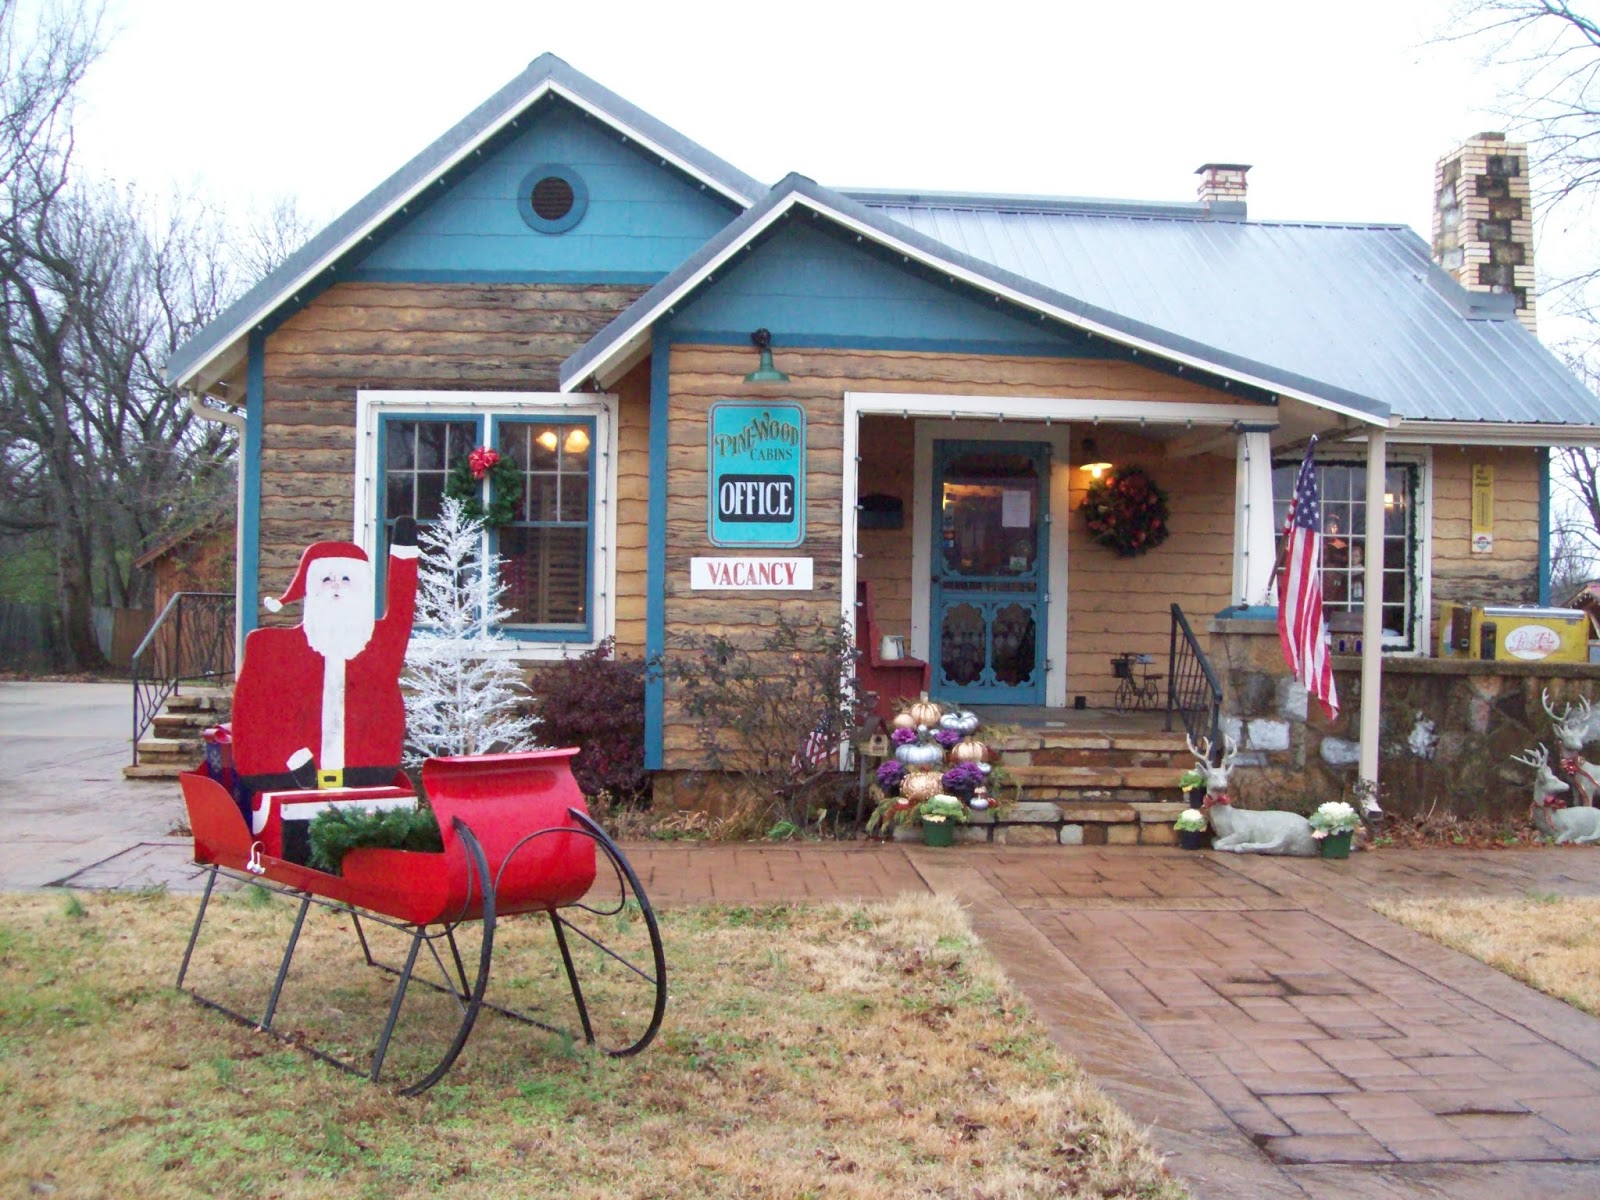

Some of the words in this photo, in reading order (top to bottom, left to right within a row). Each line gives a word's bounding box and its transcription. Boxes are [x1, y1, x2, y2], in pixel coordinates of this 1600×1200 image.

[750, 448, 793, 461] CABINS
[719, 481, 792, 515] OFFICE
[707, 562, 797, 586] VACANCY
